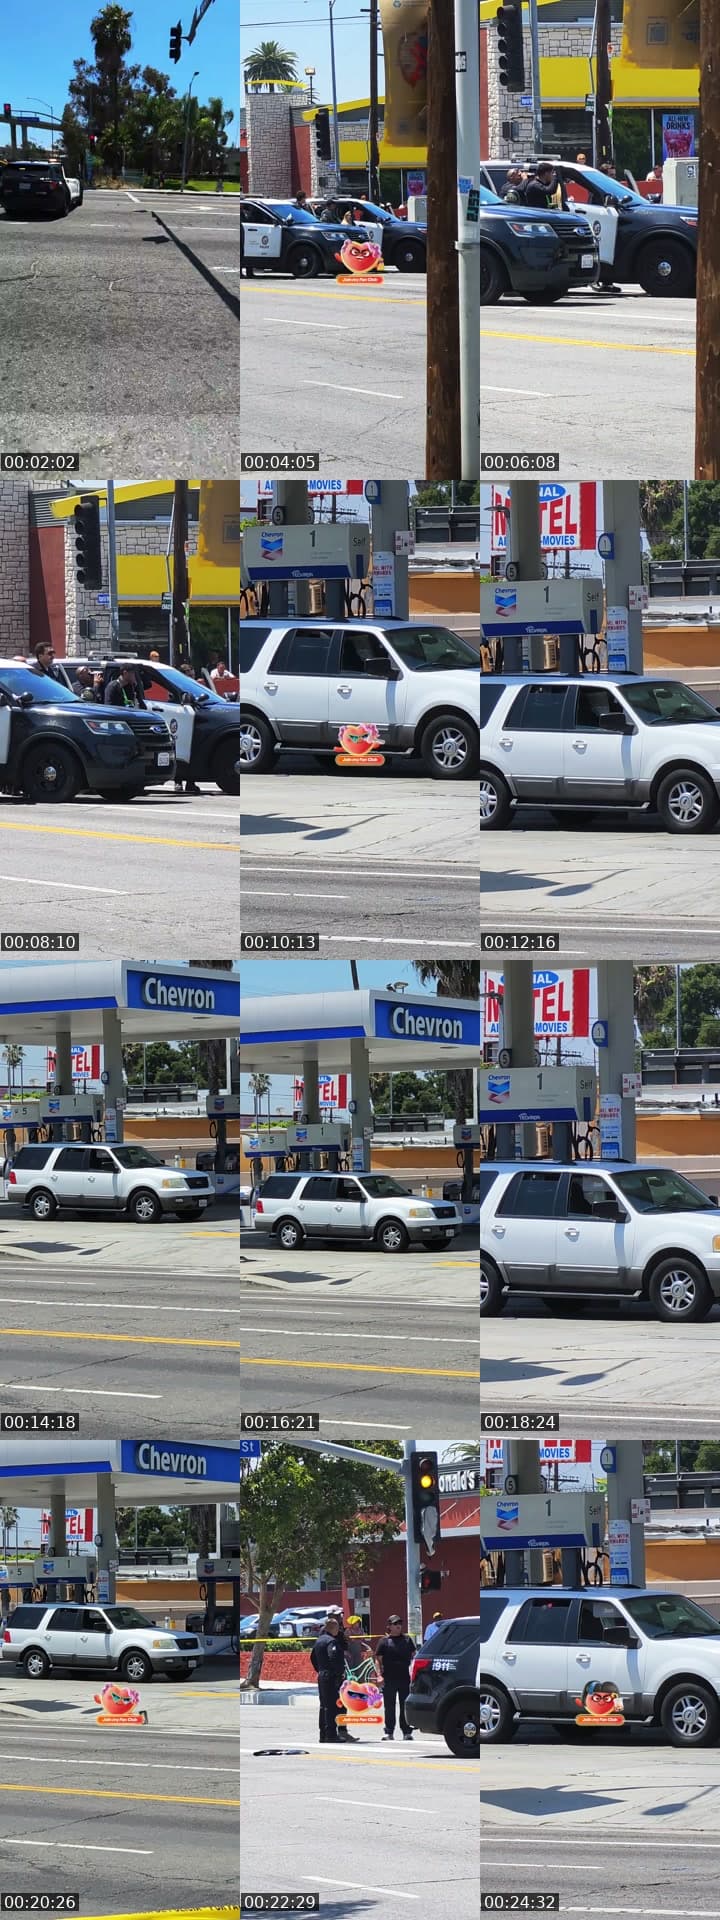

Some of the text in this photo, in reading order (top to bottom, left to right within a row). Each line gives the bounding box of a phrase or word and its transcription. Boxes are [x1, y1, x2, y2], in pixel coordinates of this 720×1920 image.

[495, 492, 577, 535] MTEL
[310, 530, 316, 547] 1
[544, 586, 549, 603] 1
[586, 592, 599, 601] Self
[144, 977, 214, 1009] Chevron
[488, 979, 570, 1022] MTEL
[392, 1007, 463, 1039] Chevron
[48, 1051, 91, 1072] MTEL
[502, 1055, 507, 1064] 5
[296, 1080, 337, 1101] MTEL
[537, 1073, 542, 1090] 1
[580, 1080, 592, 1089] Self
[242, 1441, 254, 1452] St
[138, 1443, 207, 1475] Chevron
[439, 1471, 475, 1492] onald's
[508, 1481, 513, 1490] 5
[545, 1500, 551, 1516] 1
[43, 1514, 83, 1535] MTEL
